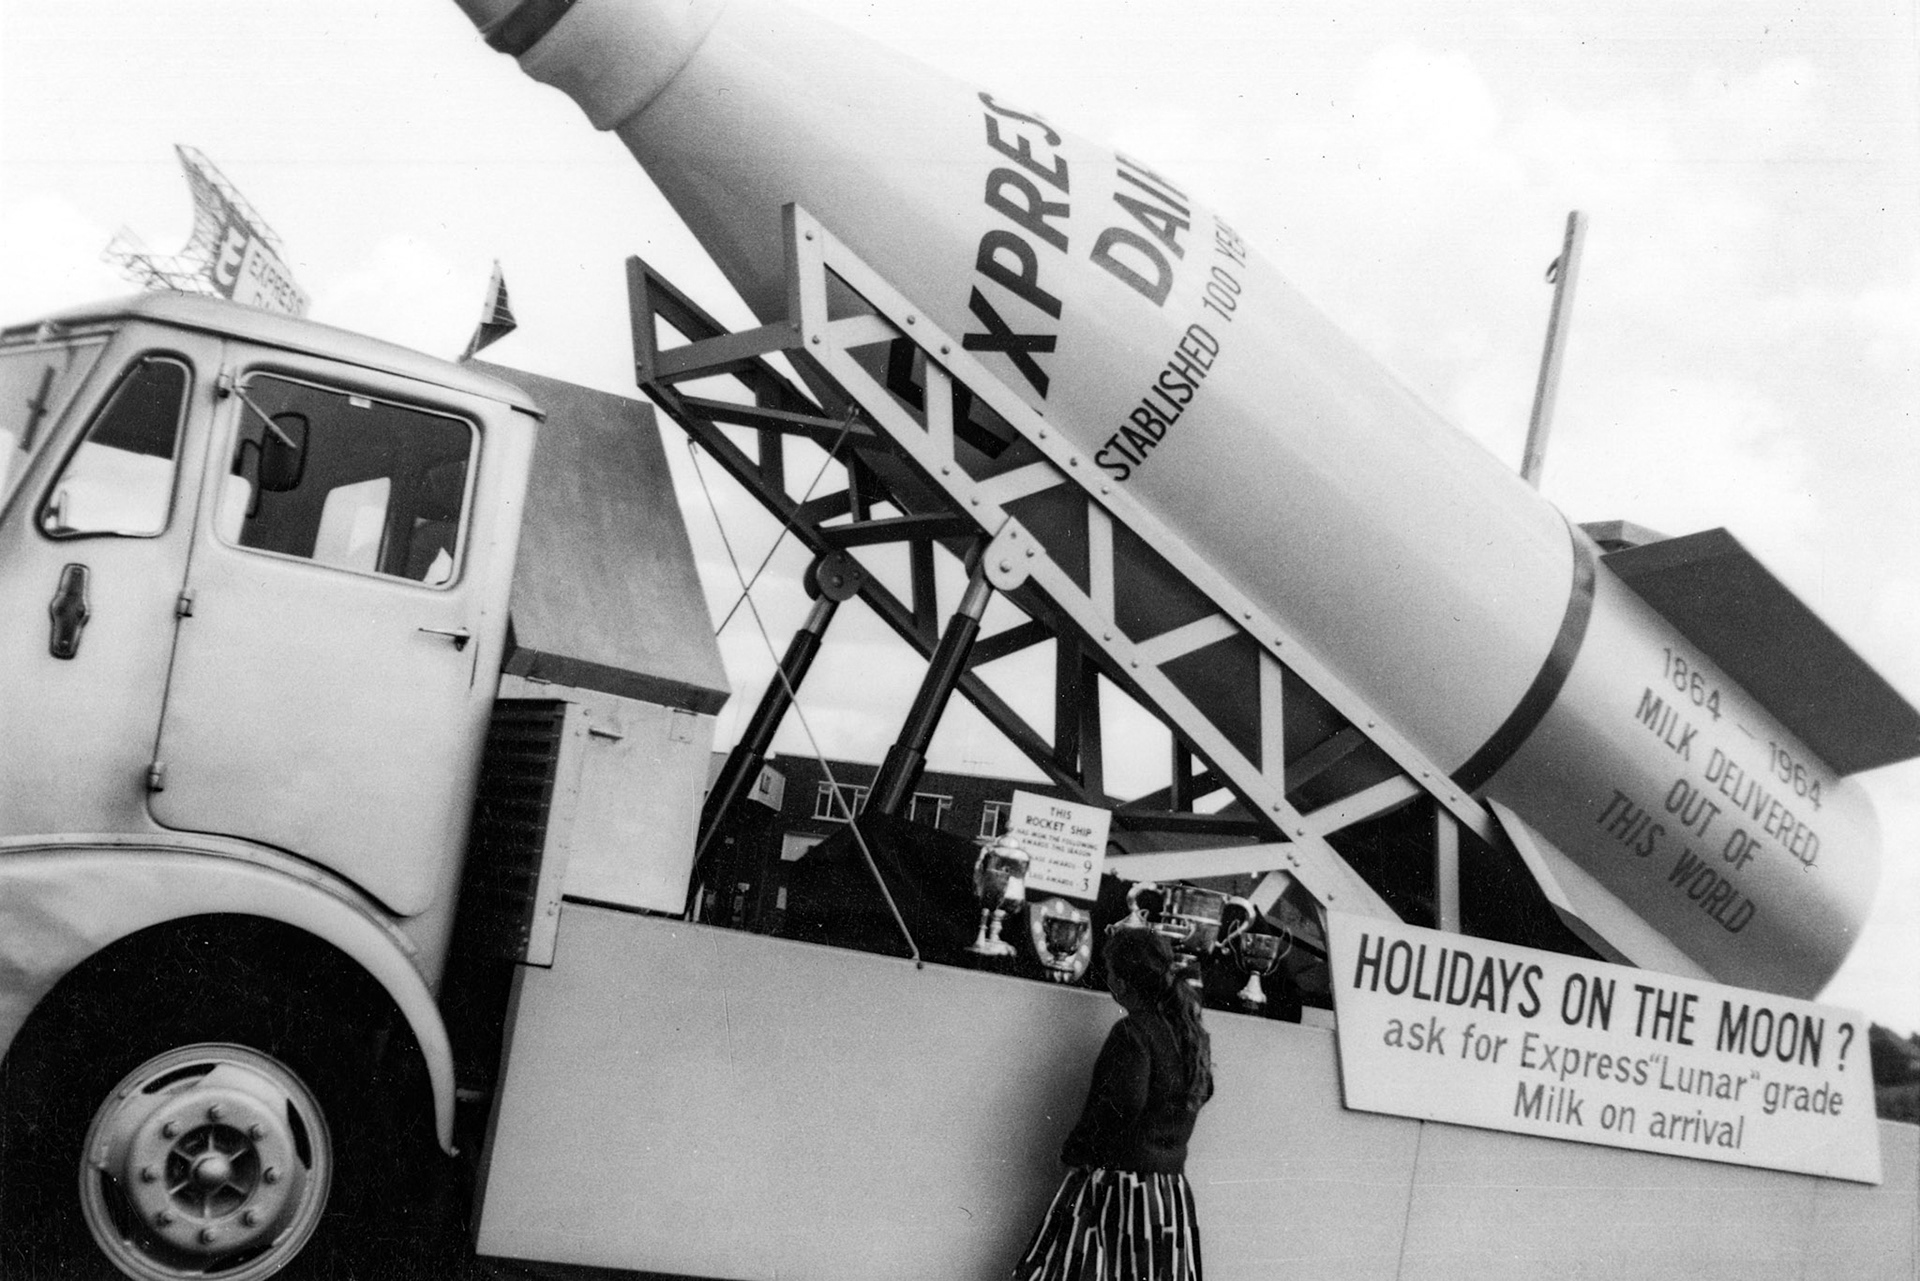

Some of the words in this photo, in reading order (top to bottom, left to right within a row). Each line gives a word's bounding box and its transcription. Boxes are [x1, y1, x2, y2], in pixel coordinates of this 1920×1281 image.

[1090, 149, 1191, 308] DAI
[249, 249, 304, 314] EXPRESS
[1094, 323, 1220, 482] STABLISHED
[1202, 266, 1242, 322] 100
[1635, 686, 1699, 762] MILK
[1704, 746, 1821, 866] DELIVERED
[1663, 648, 1722, 722] 1864
[1768, 740, 1822, 812] 1964
[1026, 815, 1065, 833] ROCKET
[1070, 825, 1093, 837] SHIP
[1050, 806, 1072, 820] THIS
[1596, 788, 1666, 858] THIS
[1667, 849, 1756, 934] WORLD
[1664, 778, 1722, 838] OUT
[1722, 828, 1763, 872] OF
[1081, 877, 1090, 892] 3
[1083, 859, 1093, 874] 9
[1353, 933, 1544, 1018] HOLIDAYS
[1561, 972, 1616, 1032] ON
[1634, 984, 1699, 1046] THE
[1716, 1000, 1825, 1068] MOON
[1383, 1016, 1447, 1056] ask
[1461, 1023, 1508, 1063] for
[1762, 1081, 1844, 1116] grade
[1513, 1081, 1585, 1127] Milk
[1600, 1103, 1637, 1135] on
[1648, 1109, 1745, 1149] arrival
